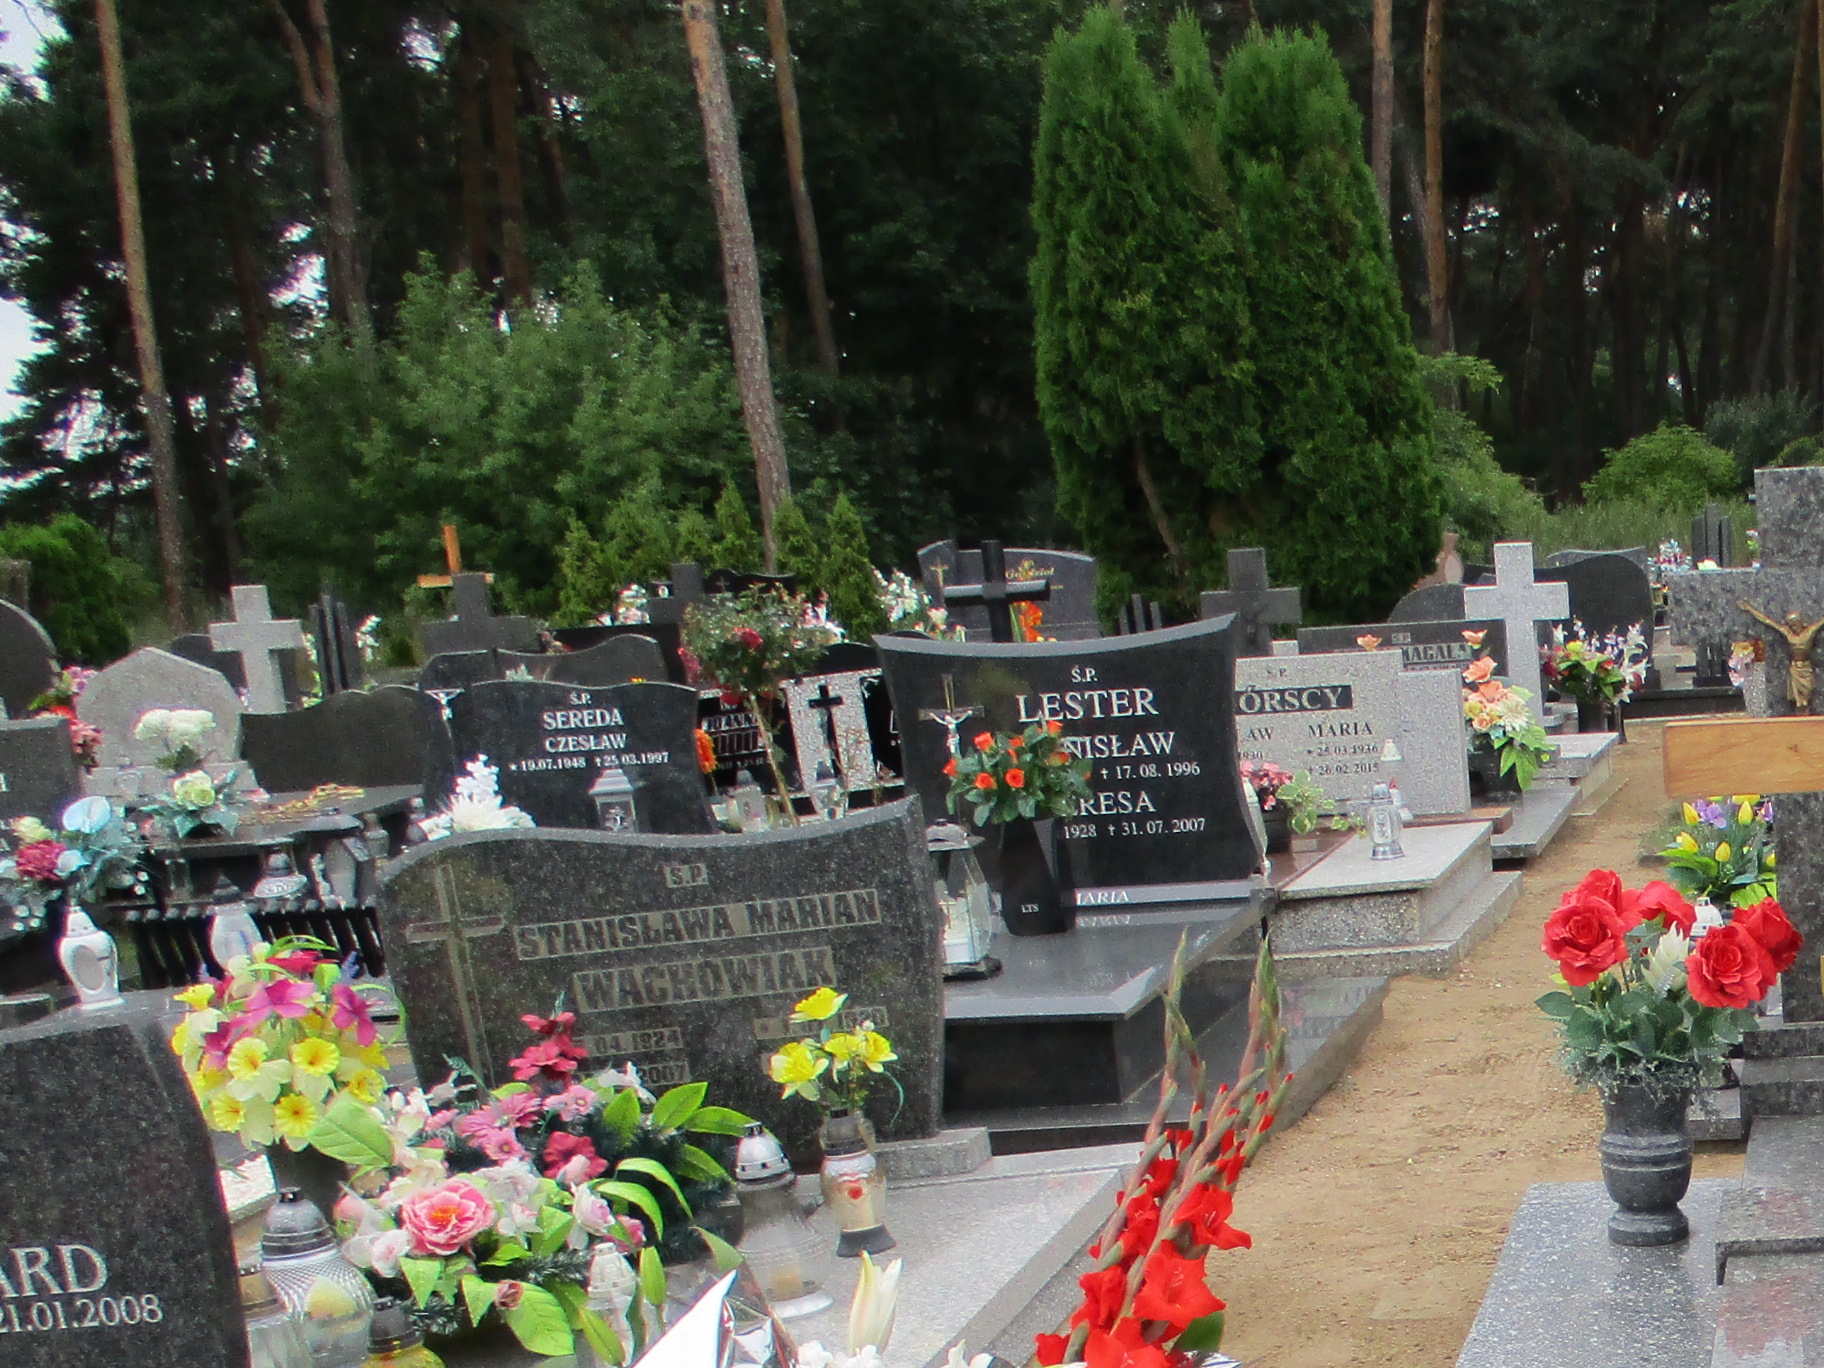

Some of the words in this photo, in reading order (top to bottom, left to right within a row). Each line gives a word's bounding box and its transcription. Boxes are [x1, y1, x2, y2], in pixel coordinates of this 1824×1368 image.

[1016, 687, 1159, 722] LESTER
[1239, 685, 1343, 714] ÓRSCY
[543, 708, 625, 731] SEREDA
[1308, 721, 1374, 738] MARIA
[1060, 732, 1175, 759] NISŁAW
[1061, 790, 1157, 817] RESA
[1063, 825, 1098, 840] 1928
[1076, 890, 1130, 906] ARIA
